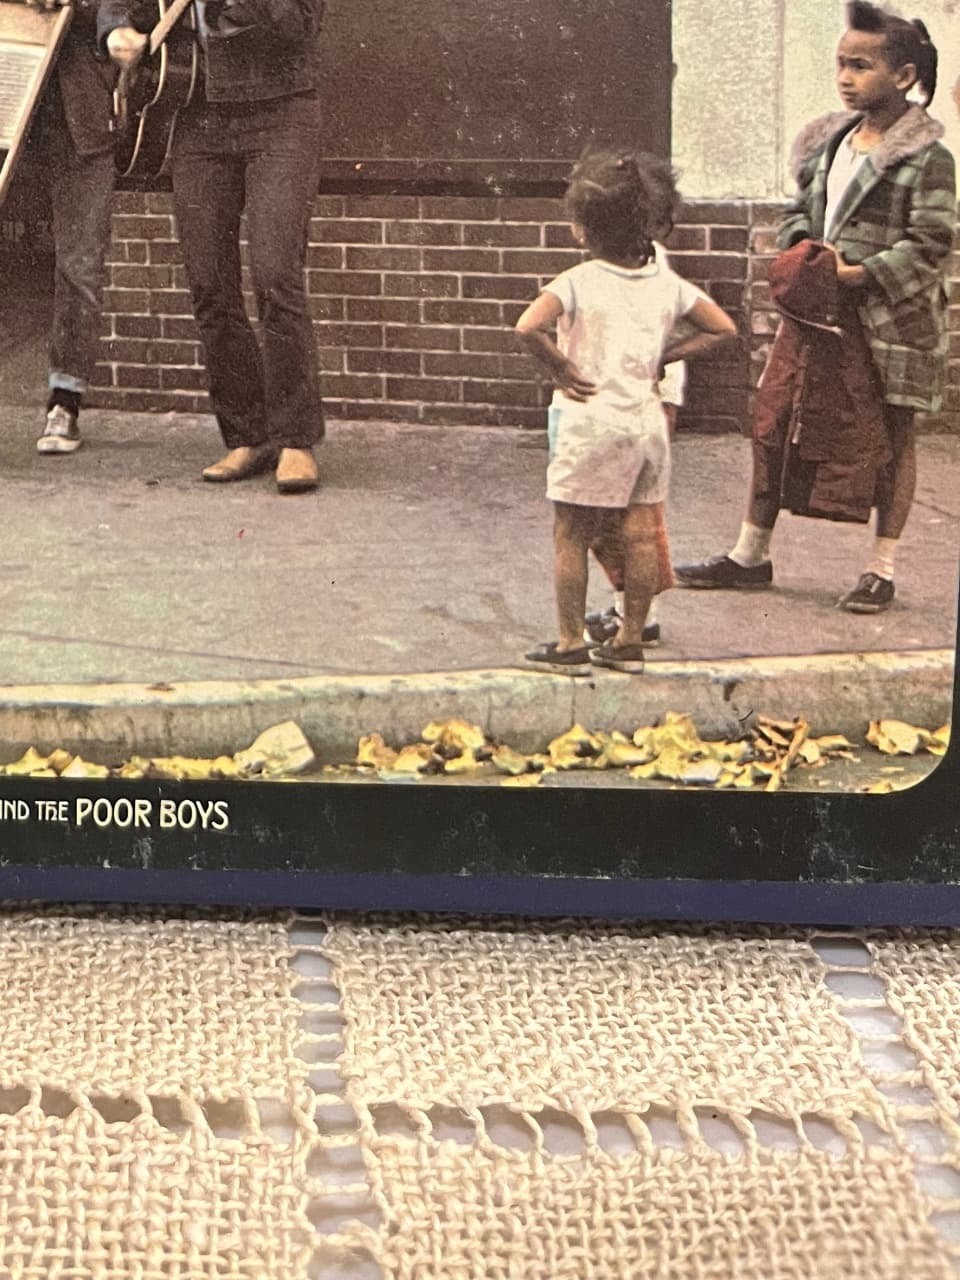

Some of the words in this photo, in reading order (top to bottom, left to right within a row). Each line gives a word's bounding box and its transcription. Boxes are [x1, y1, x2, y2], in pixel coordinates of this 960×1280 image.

[35, 800, 69, 822] THE
[75, 798, 153, 828] POOR
[159, 799, 229, 830] BOYS
